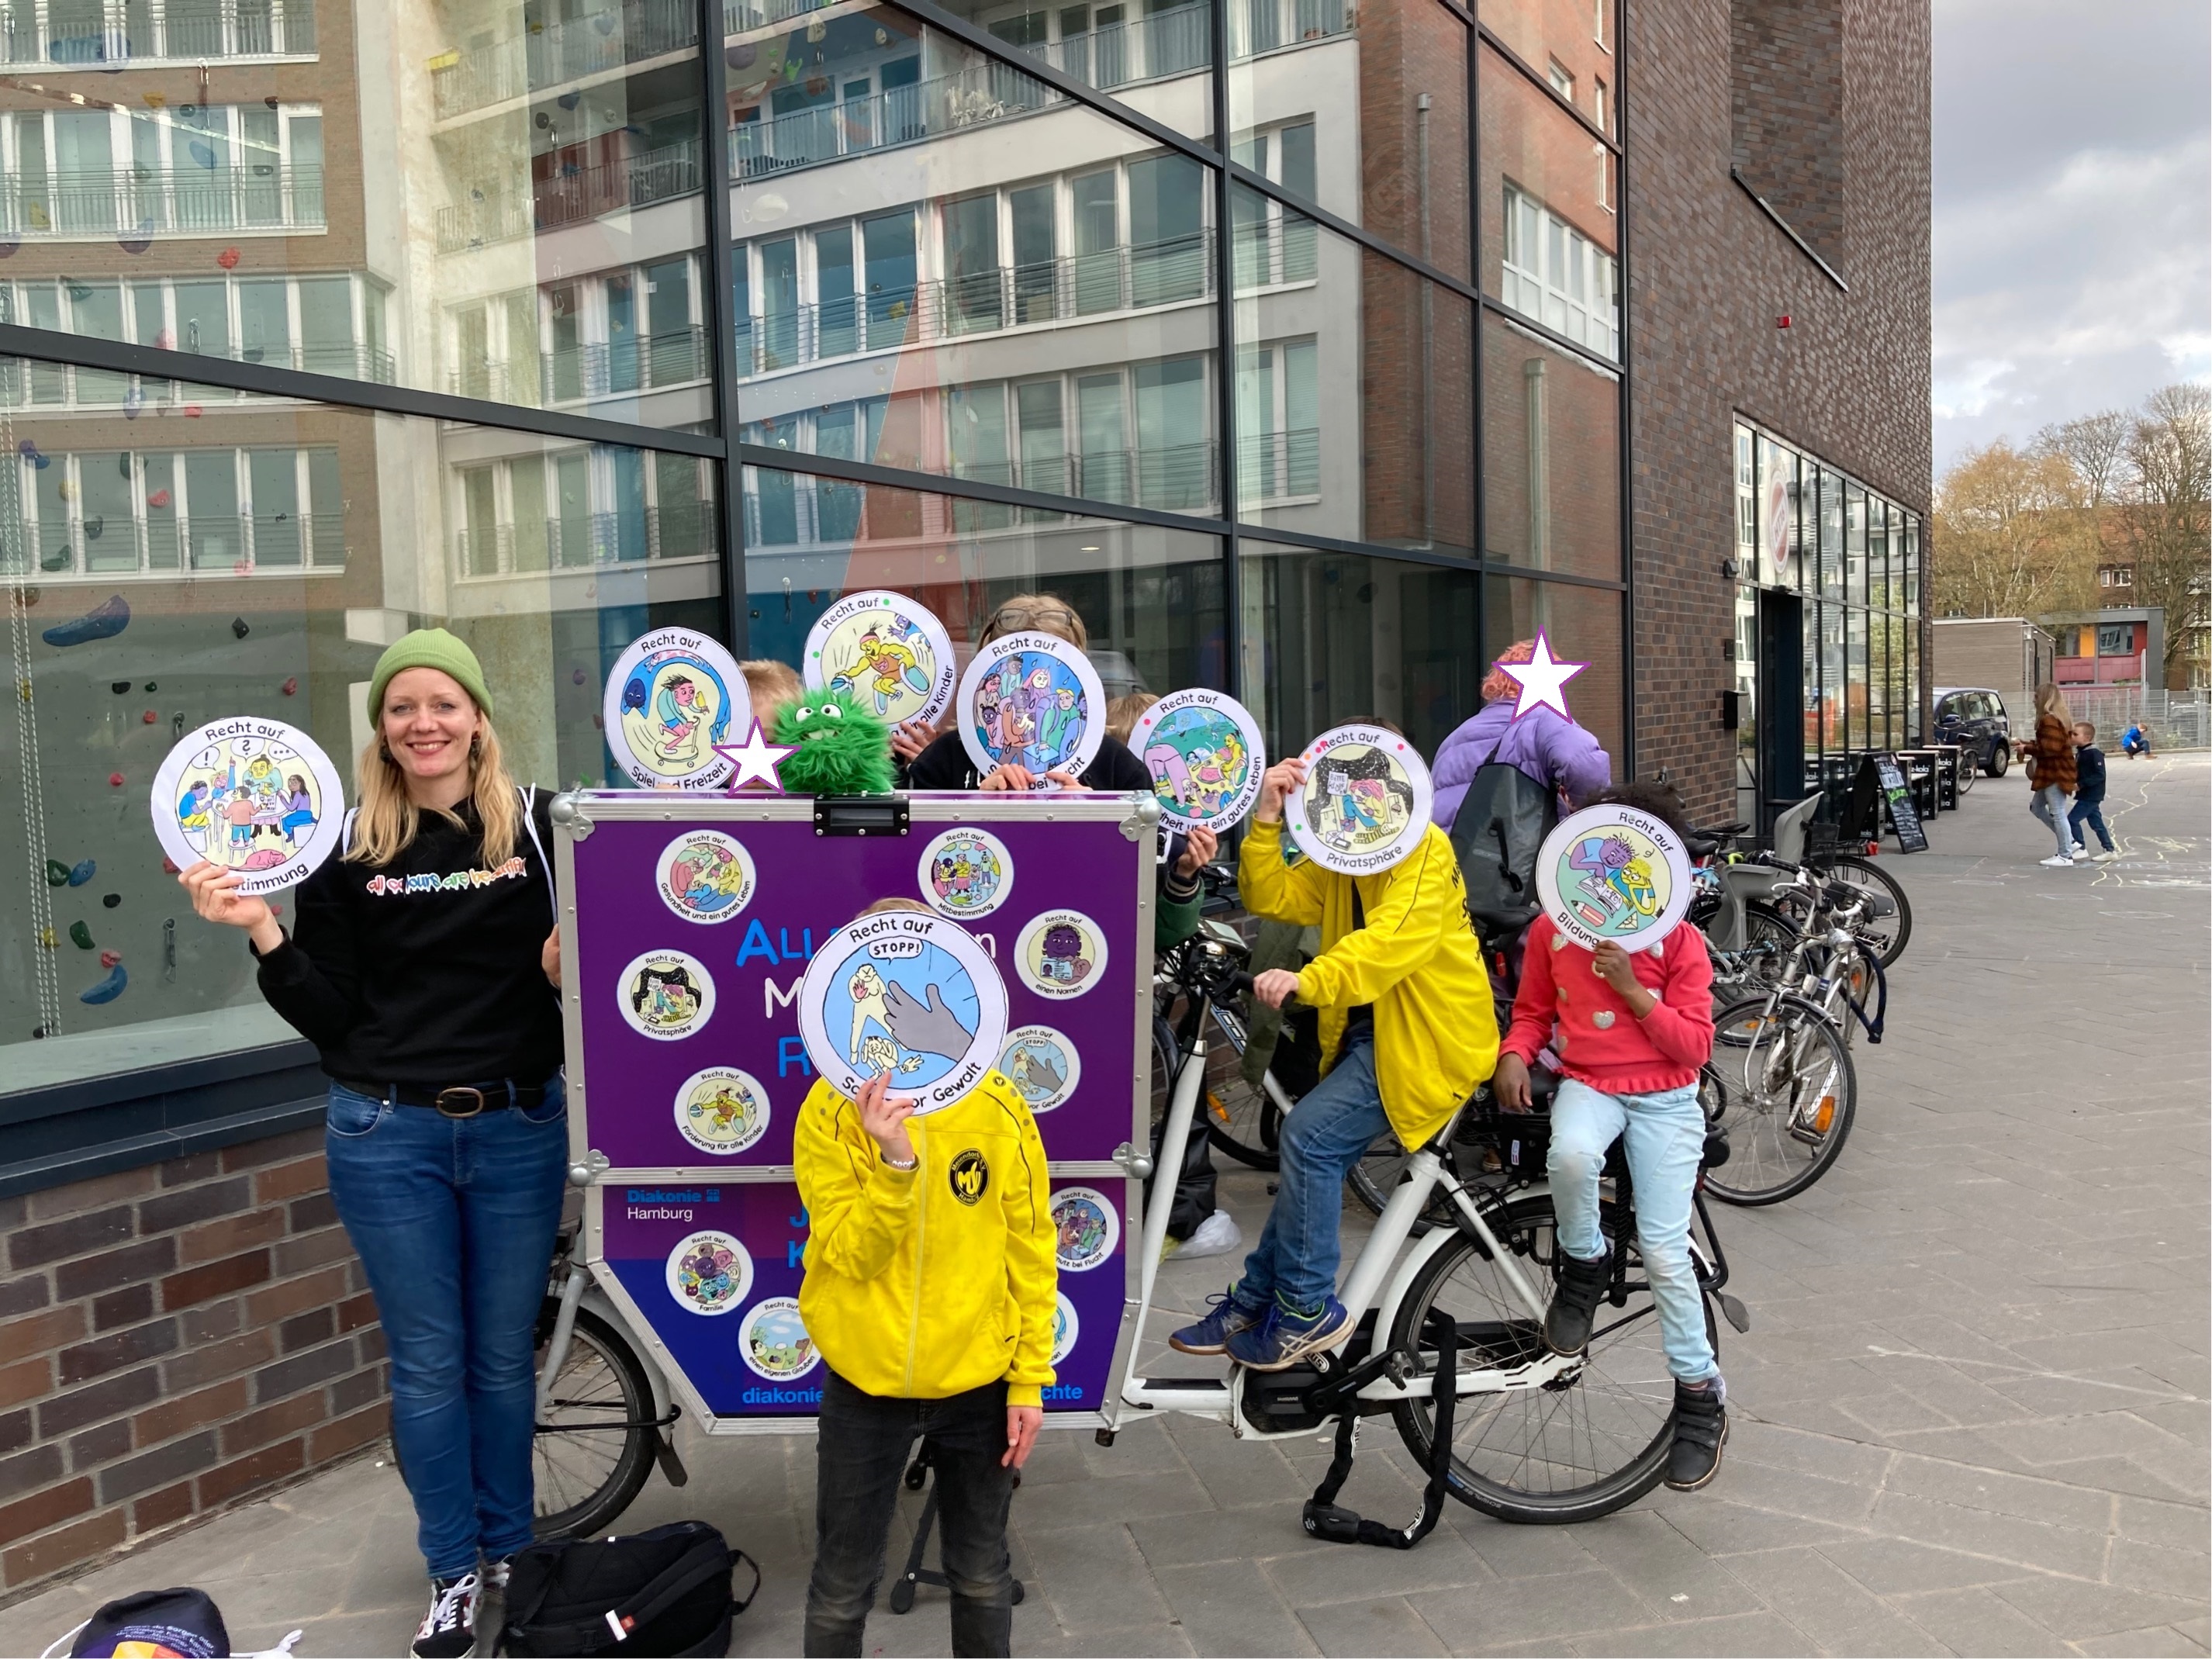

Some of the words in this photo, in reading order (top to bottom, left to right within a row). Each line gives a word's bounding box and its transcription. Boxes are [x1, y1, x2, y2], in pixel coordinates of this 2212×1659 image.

[821, 602, 855, 630] Recht
[857, 597, 879, 608] auf
[641, 634, 675, 652] Recht
[680, 637, 702, 650] auf
[991, 638, 1029, 657] Recht
[1034, 639, 1058, 652] auf
[934, 665, 953, 706] Kinder
[1160, 693, 1194, 713] Recht
[1198, 694, 1218, 705] auf
[206, 722, 251, 741] Recht
[257, 724, 285, 738] auf
[1359, 733, 1380, 743] auf
[1065, 755, 1085, 776] cht
[631, 766, 655, 788] Spiel
[684, 762, 727, 790] Freizeit
[1211, 817, 1228, 829] ein
[1229, 793, 1251, 823] gutes
[1249, 756, 1261, 793] Leben
[686, 835, 710, 844] Recht
[946, 832, 968, 842] Recht
[970, 833, 984, 842] auf
[1619, 812, 1652, 834] Recht
[1654, 834, 1674, 852] auf
[1326, 845, 1402, 869] Privatsphäre
[241, 863, 309, 891] timmung
[367, 875, 385, 896] all
[442, 871, 470, 890] are
[661, 883, 691, 917] Gesundheit
[721, 902, 740, 918] gutes
[739, 880, 751, 903] Leben
[938, 902, 994, 916] Mitbestimmung
[1045, 914, 1066, 924] Recht
[1068, 916, 1083, 925] auf
[849, 918, 897, 942] Recht
[904, 920, 933, 935] auf
[1557, 912, 1599, 948] Bildung
[736, 918, 836, 967] ALL
[874, 942, 920, 956] STOPP!
[645, 955, 668, 965] Recht
[1035, 983, 1054, 994] einen
[1056, 985, 1083, 995] Namen
[643, 1025, 692, 1037] Privatsphäre
[1016, 1028, 1037, 1039] Recht
[701, 1070, 724, 1080] Recht
[933, 1063, 982, 1102] Gewalt
[1042, 1093, 1065, 1108] Gewalt
[682, 1125, 716, 1150] Förderung
[743, 1125, 763, 1143] Kinder
[627, 1189, 702, 1203] Diakonie
[1060, 1191, 1080, 1201] Recht
[627, 1207, 693, 1222] Hamburg
[691, 1236, 712, 1244] Recht
[714, 1236, 727, 1245] auf
[1056, 1256, 1070, 1267] hutz
[1084, 1252, 1104, 1266] Flucht
[764, 1301, 784, 1311] Recht
[748, 1357, 764, 1371] einen
[764, 1368, 791, 1377] eigenen
[792, 1356, 815, 1374] Glauben
[1041, 1384, 1083, 1400] chte
